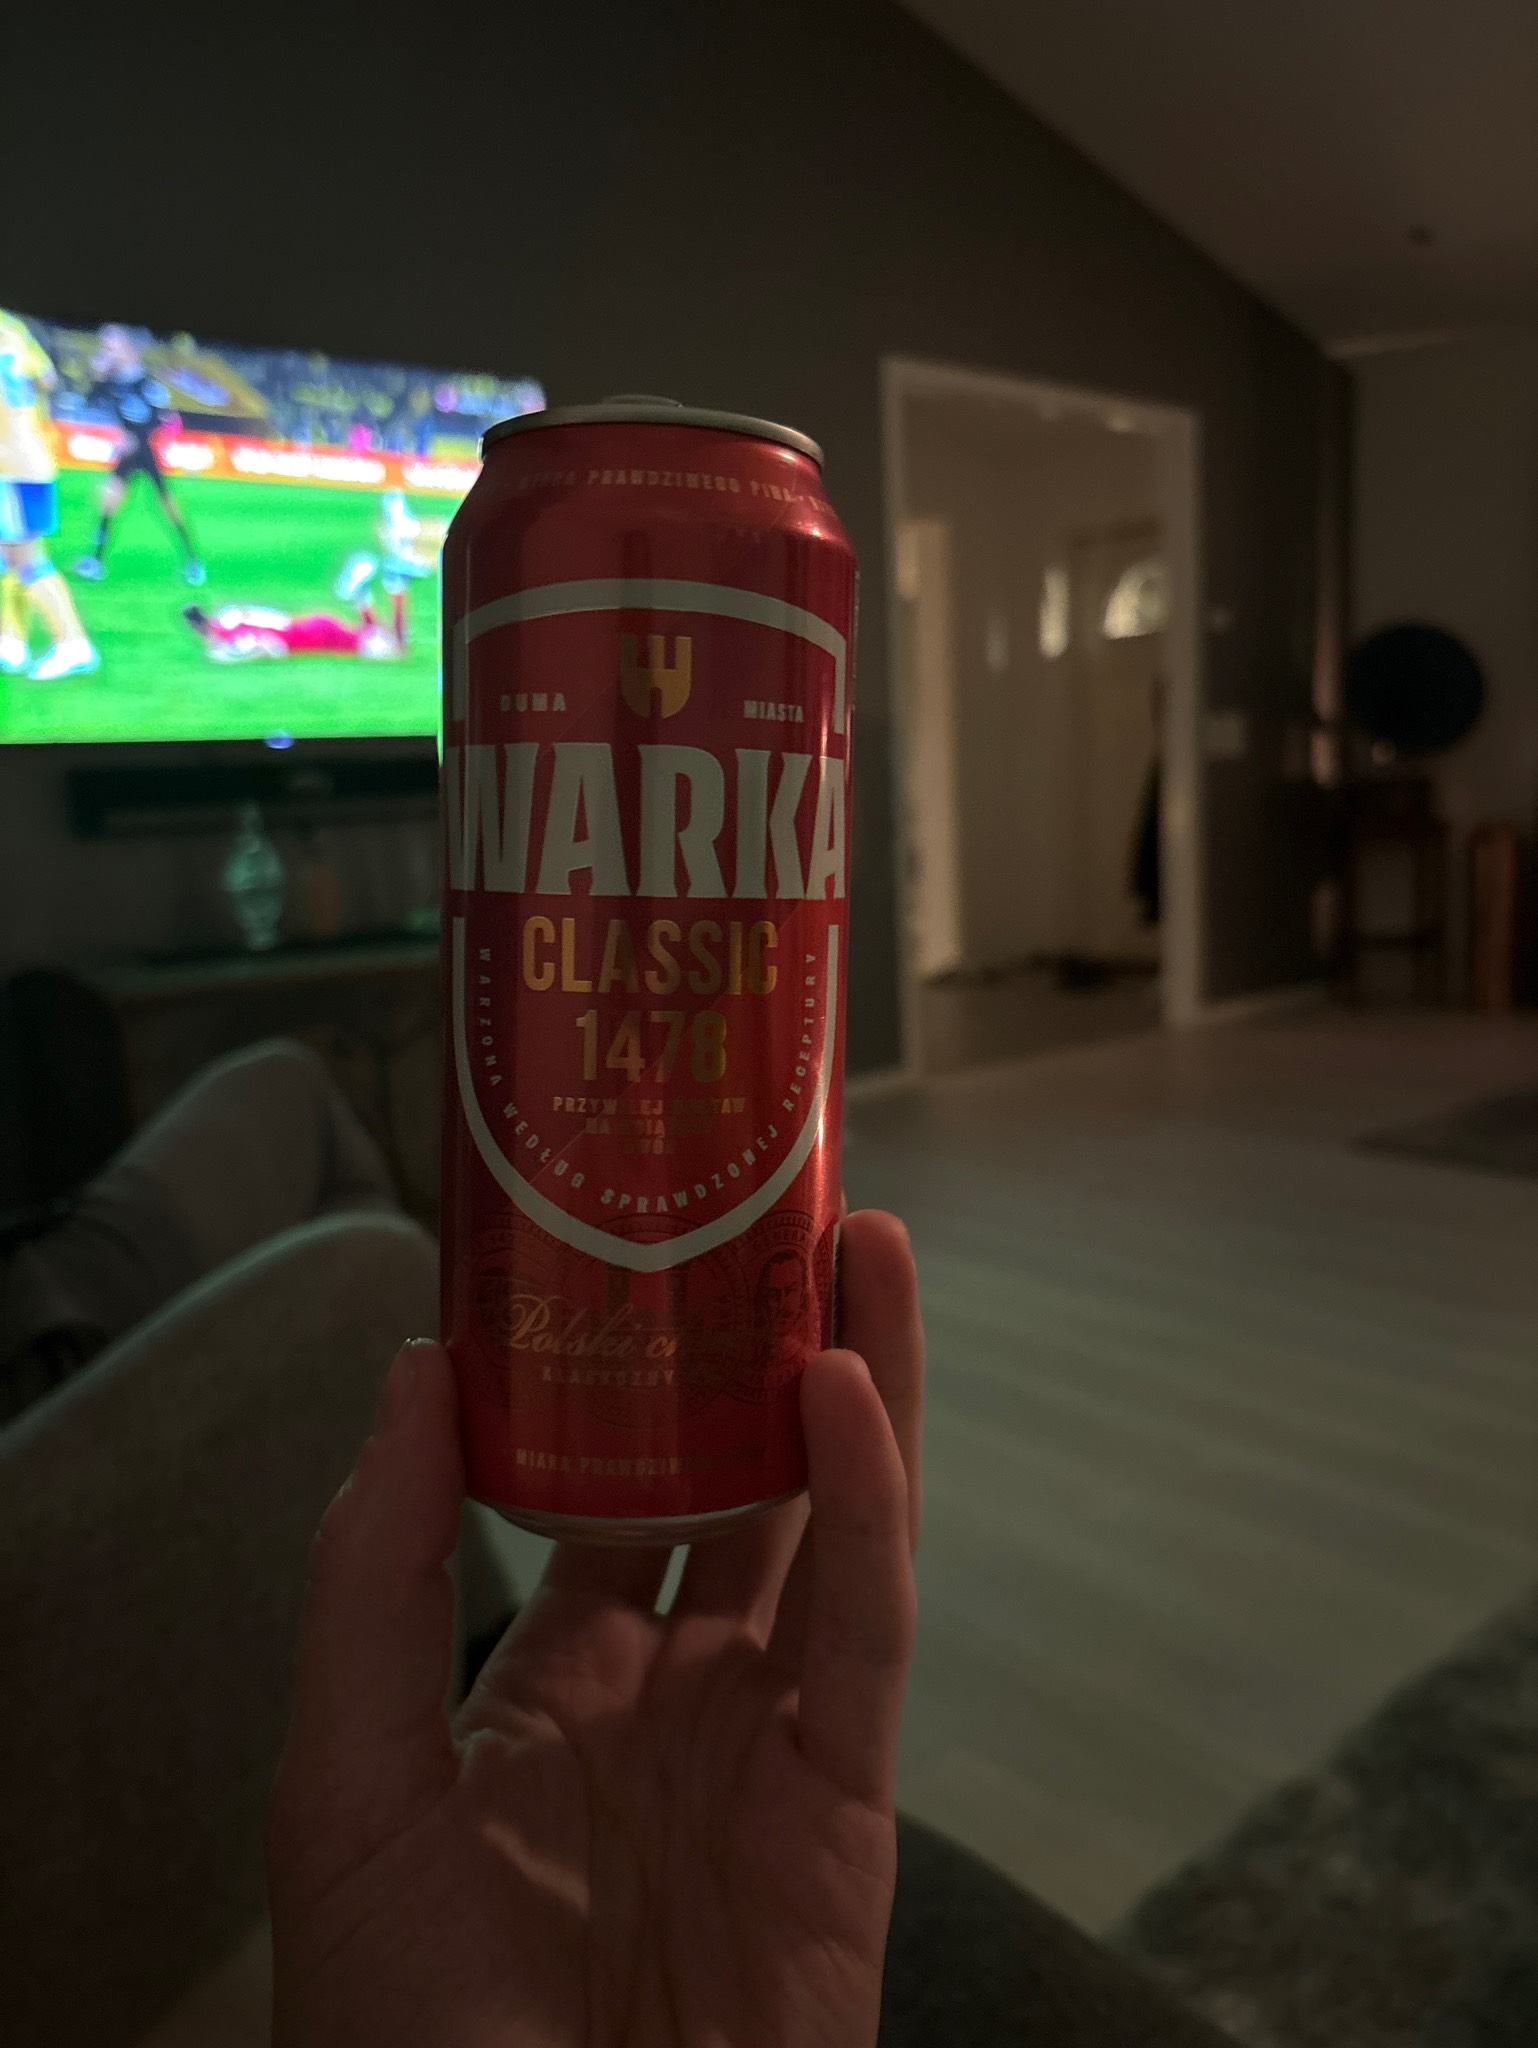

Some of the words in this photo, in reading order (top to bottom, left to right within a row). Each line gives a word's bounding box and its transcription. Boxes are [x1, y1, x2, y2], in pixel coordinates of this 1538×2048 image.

[500, 691, 567, 713] DUMA
[742, 699, 804, 724] MIASTA
[443, 741, 846, 901] WARKA
[522, 915, 778, 996] CLASSIC
[575, 1009, 728, 1083] 1478
[599, 1123, 779, 1215] SPRAWDZONEJ
[508, 1293, 643, 1357] Polski
